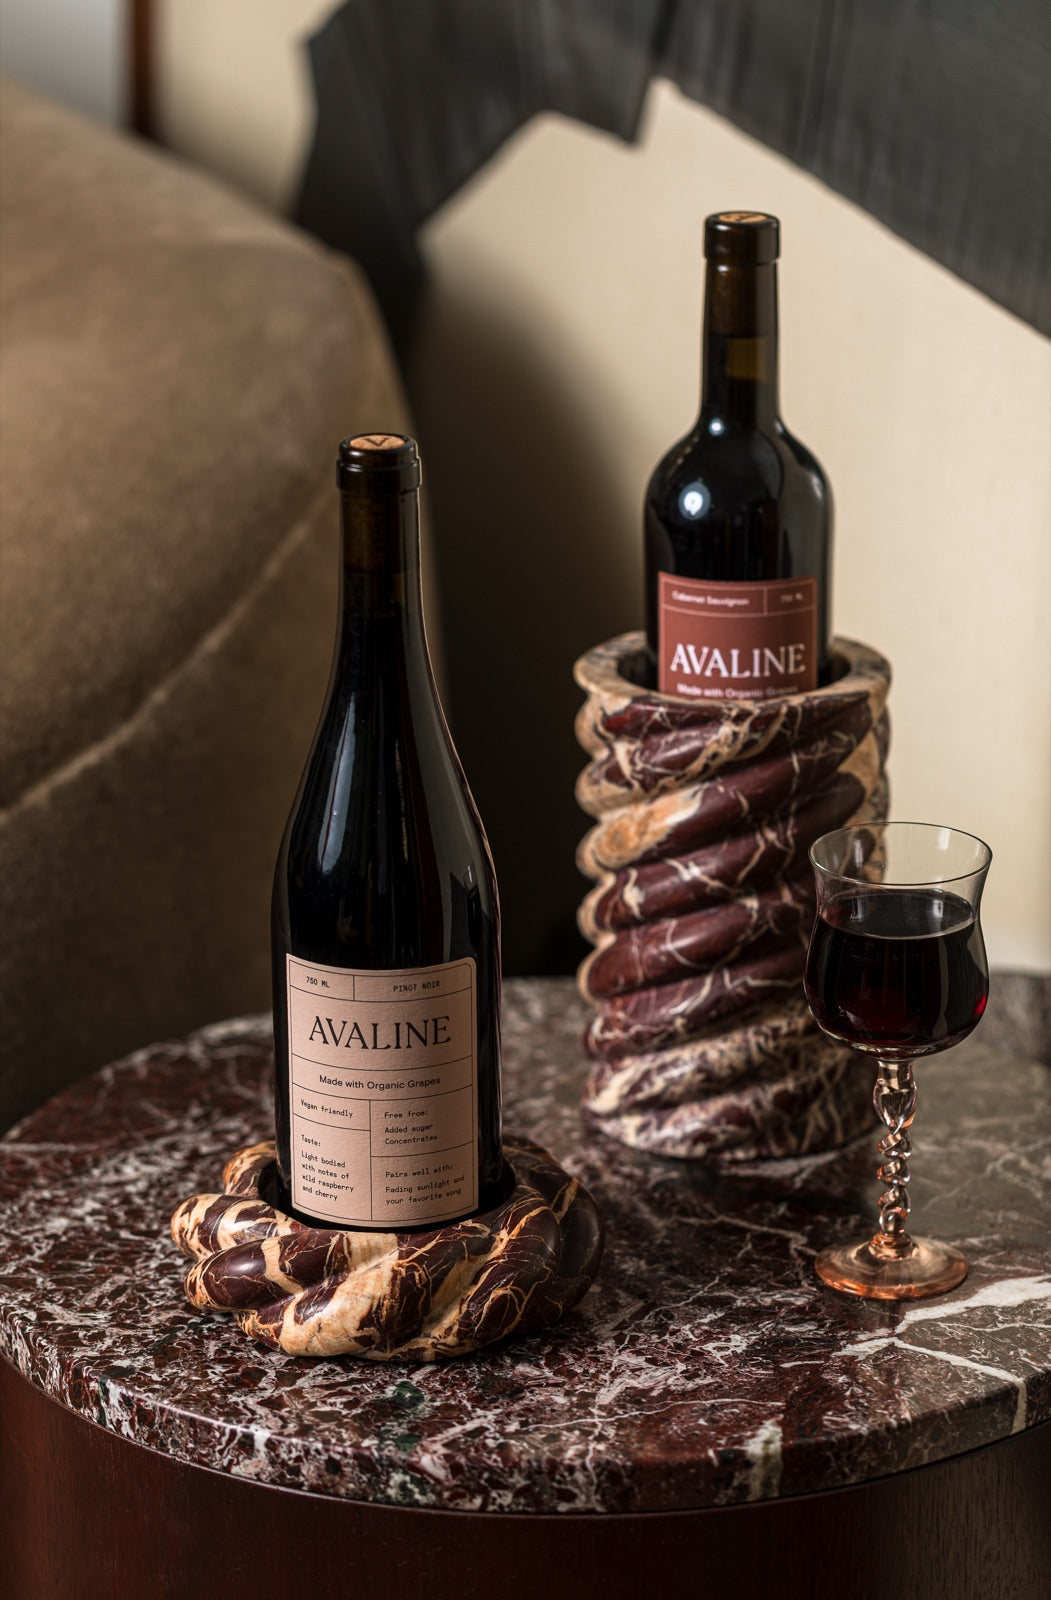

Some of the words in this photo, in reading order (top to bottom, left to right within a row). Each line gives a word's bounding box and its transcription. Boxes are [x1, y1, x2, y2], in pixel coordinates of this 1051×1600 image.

[670, 642, 807, 679] AVALINE
[677, 682, 703, 696] Made
[704, 686, 724, 698] with
[725, 687, 763, 700] Organic
[306, 976, 318, 986] 750
[321, 980, 330, 989] ML
[393, 983, 418, 992] PINOT
[422, 980, 441, 990] NOIR
[308, 1015, 452, 1050] AVALINE
[319, 1074, 343, 1087] Made
[345, 1078, 364, 1089] with
[367, 1080, 405, 1092] Organic
[407, 1076, 441, 1090] Grapes
[300, 1099, 318, 1110] Vegan
[321, 1105, 353, 1118] friendly
[408, 1110, 429, 1118] from:
[384, 1126, 408, 1134] Added
[412, 1124, 433, 1133] sugar
[301, 1134, 321, 1147] Taste:
[385, 1135, 438, 1145] Concentrates
[301, 1150, 318, 1162] Light
[321, 1157, 346, 1168] bodied
[302, 1164, 315, 1173] with
[318, 1169, 337, 1178] notes
[341, 1172, 350, 1180] of
[385, 1171, 408, 1179] Pairs
[412, 1168, 430, 1176] well
[433, 1163, 453, 1173] with:
[302, 1174, 316, 1184] wild
[318, 1179, 354, 1192] raspberry
[385, 1186, 413, 1194] Fading
[417, 1179, 450, 1191] sunlight
[453, 1173, 465, 1183] and
[302, 1185, 312, 1193] and
[315, 1189, 338, 1201] cherry
[386, 1198, 404, 1206] your
[409, 1192, 442, 1203] favorite
[446, 1188, 462, 1198] song
